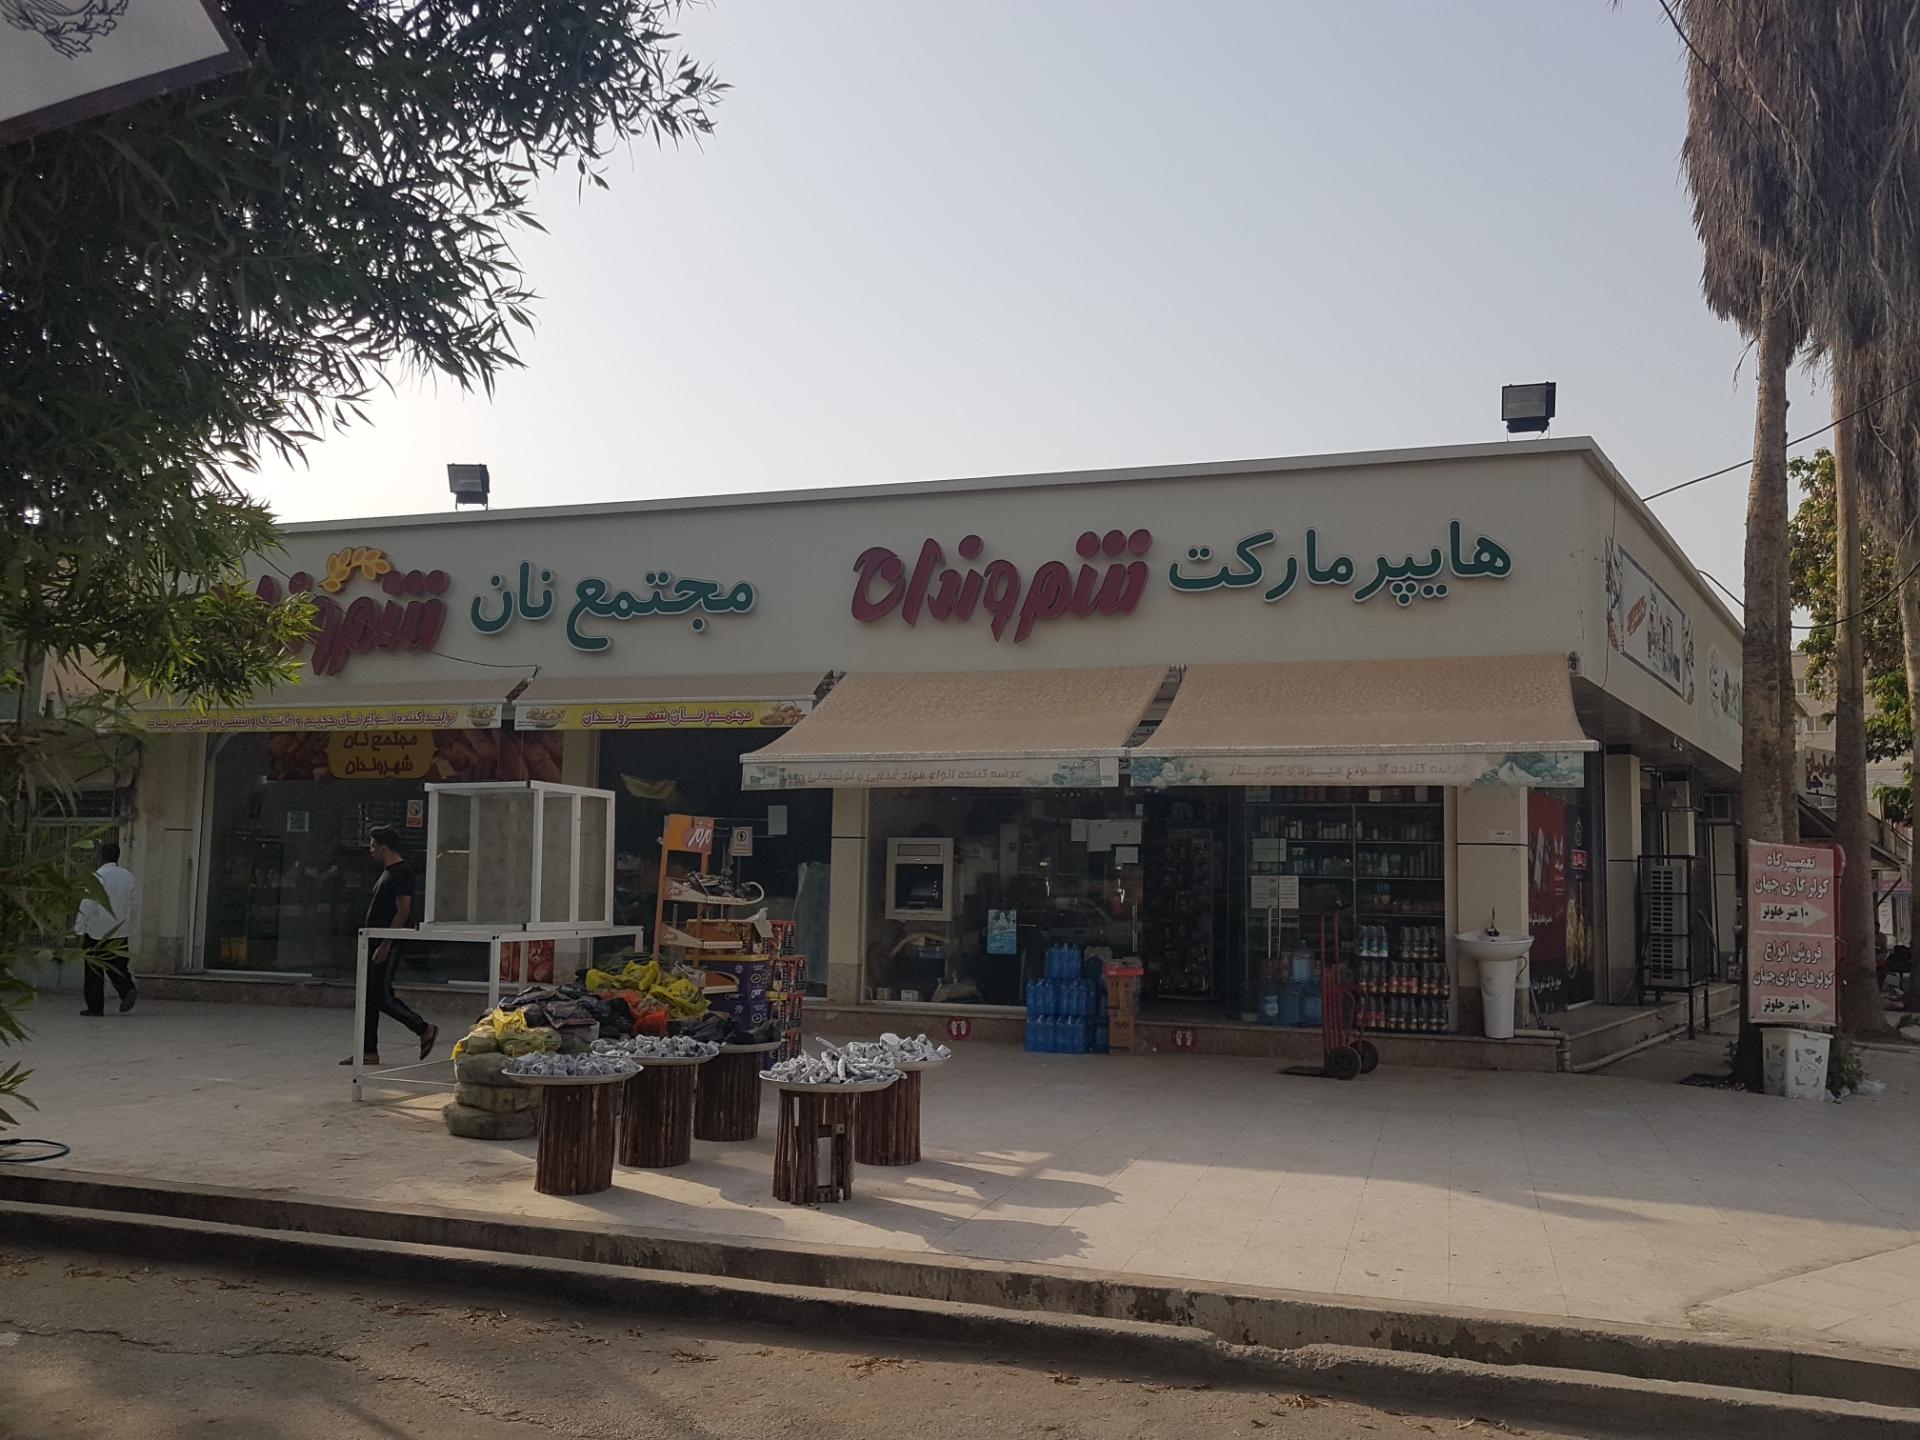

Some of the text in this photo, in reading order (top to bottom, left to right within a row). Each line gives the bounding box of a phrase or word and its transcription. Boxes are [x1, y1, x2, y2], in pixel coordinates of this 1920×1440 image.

[850, 529, 1153, 643] شهروندان
[470, 559, 555, 635] نان
[566, 571, 756, 651] مجتمع
[581, 707, 753, 727] مجتمع نان شهروندان
[371, 731, 417, 752] مجتمع
[345, 754, 413, 775] شهروندان
[1391, 763, 1426, 775] کننده
[808, 771, 856, 784] نوشیدنی
[857, 773, 863, 782] و
[901, 770, 926, 783] مواد
[929, 769, 956, 783] انواع
[958, 766, 987, 779] کننده
[990, 767, 1022, 780] عرضه
[1754, 873, 1830, 900] کولر گازی جهان
[1762, 905, 1783, 920] جلوتر
[1786, 908, 1798, 921] متر
[1764, 940, 1823, 964] فروش انواع
[1753, 966, 1776, 986] جهان
[1797, 968, 1834, 990] کولرهای
[1763, 998, 1785, 1013] جلوتر
[1788, 1000, 1799, 1013] متر
